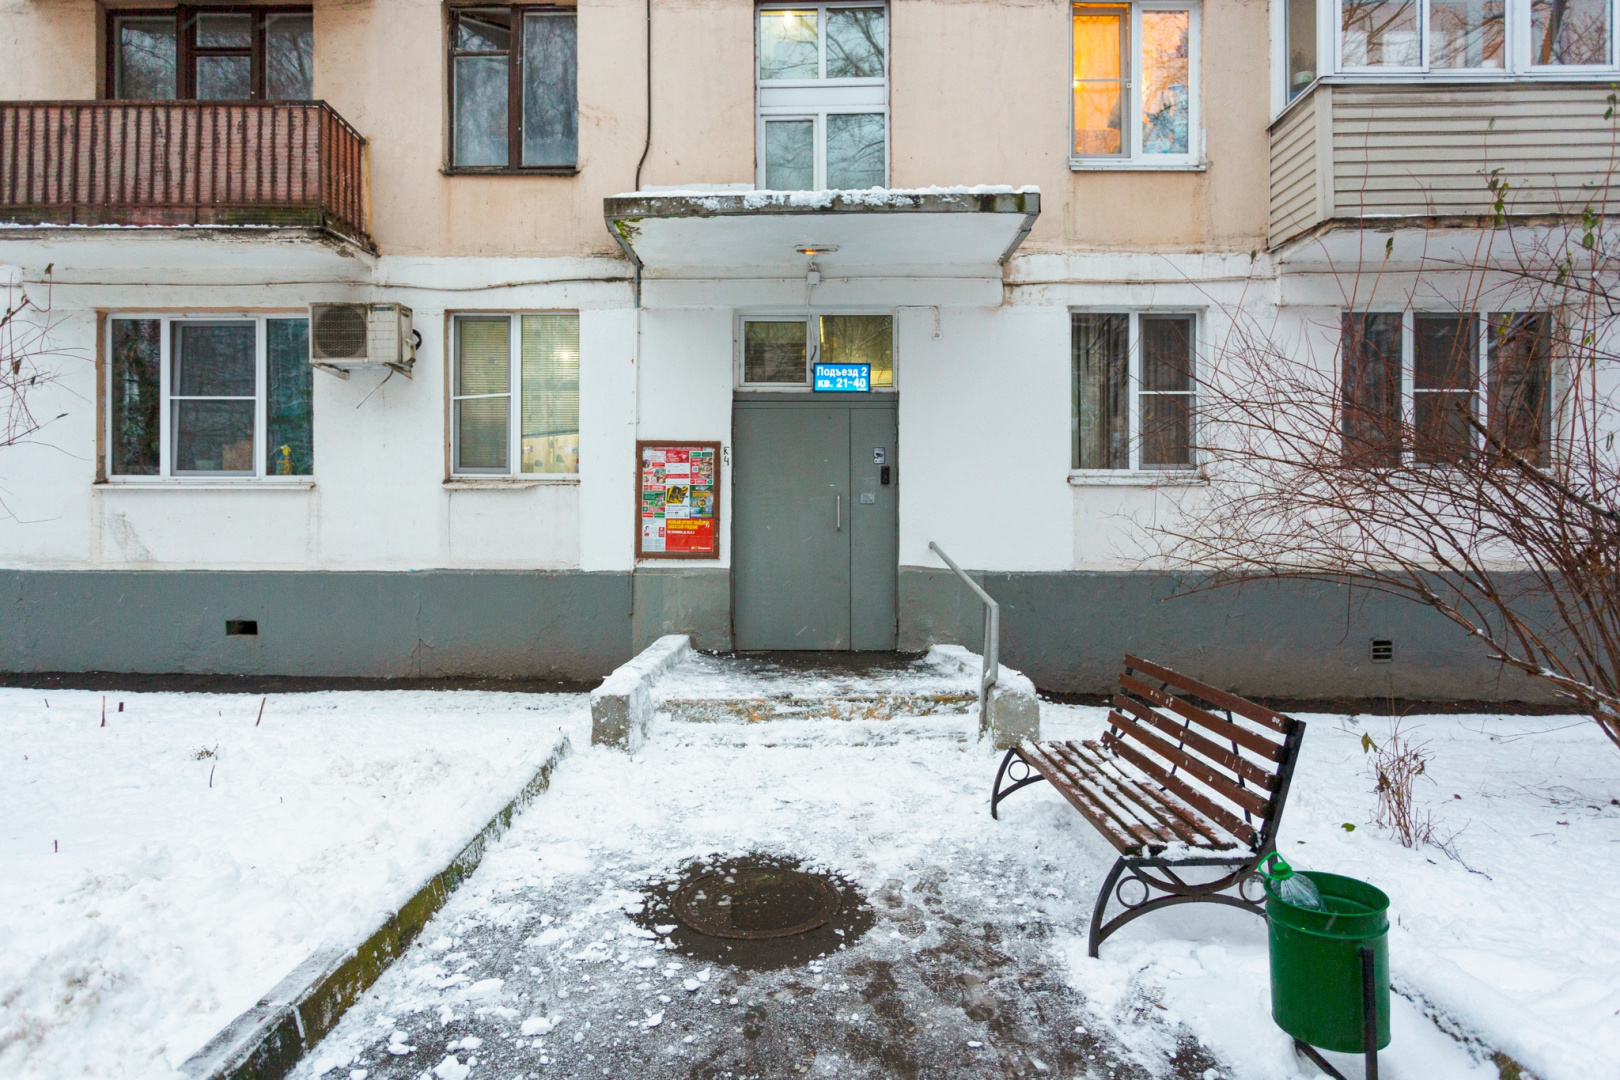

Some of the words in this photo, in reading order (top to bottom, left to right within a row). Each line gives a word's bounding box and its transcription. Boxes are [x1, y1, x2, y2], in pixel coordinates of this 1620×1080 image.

[816, 366, 858, 378] Подъезд
[861, 367, 867, 376] 2
[818, 380, 833, 388] кв.
[836, 378, 866, 388] 21-40
